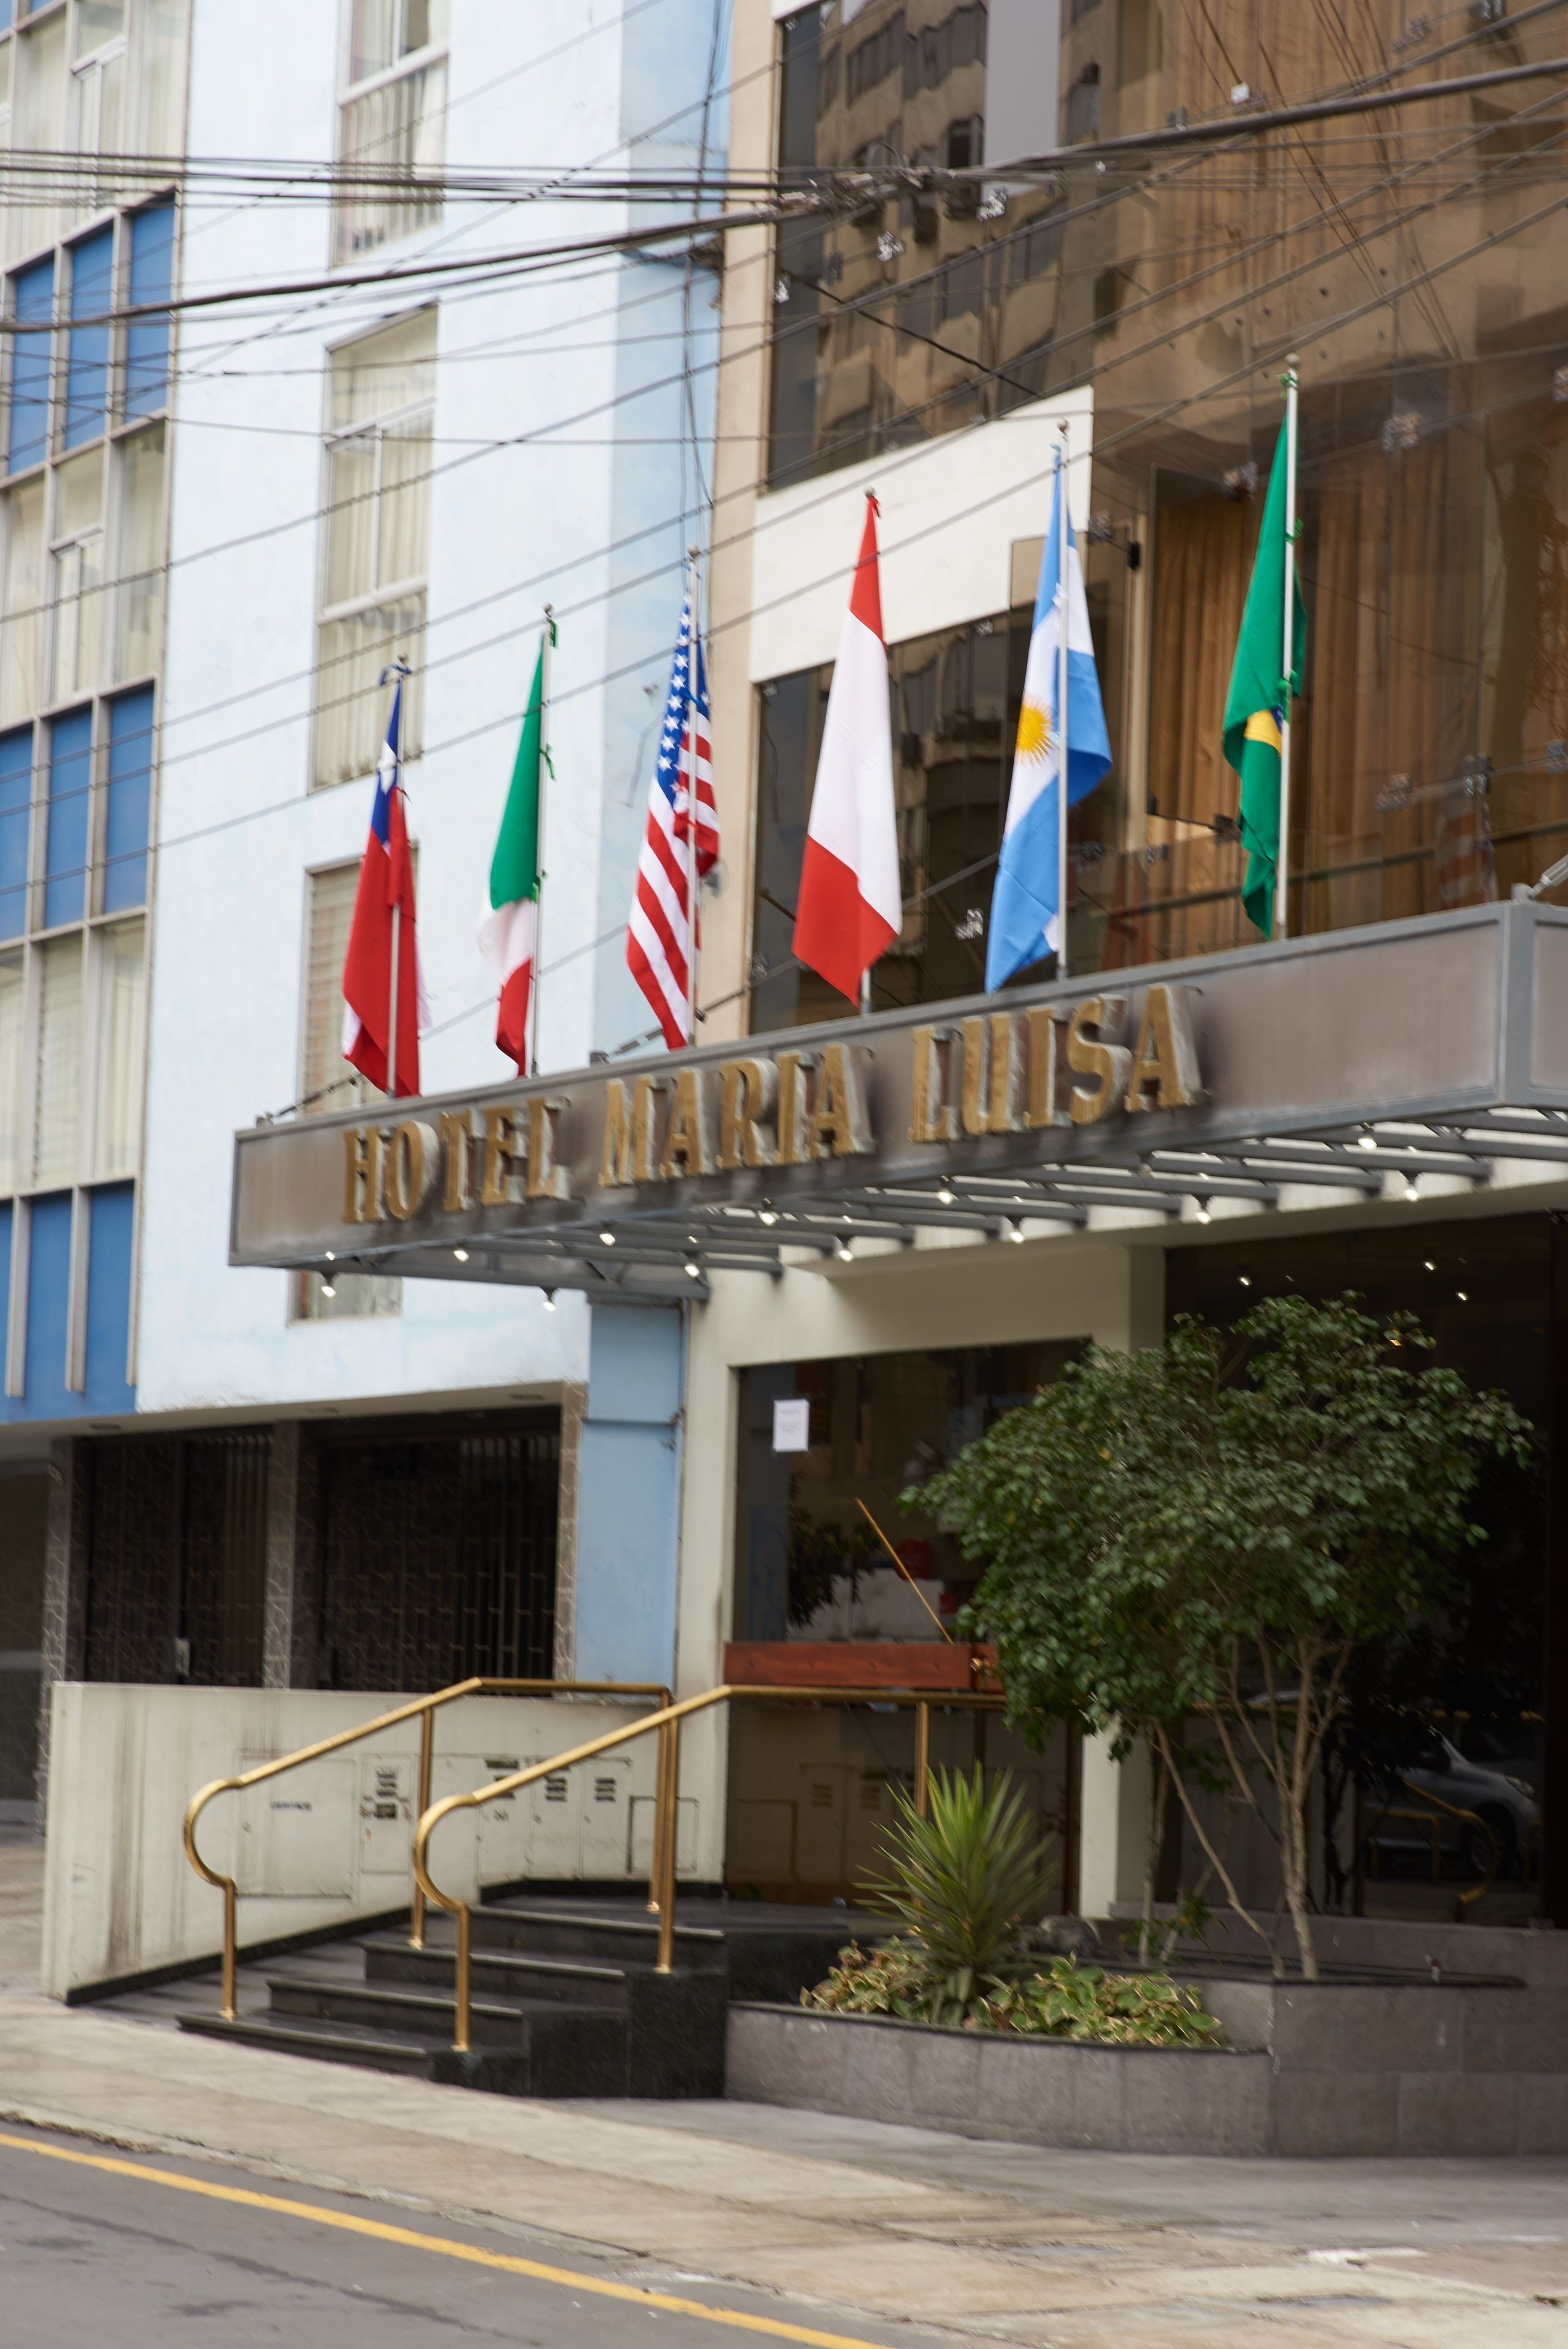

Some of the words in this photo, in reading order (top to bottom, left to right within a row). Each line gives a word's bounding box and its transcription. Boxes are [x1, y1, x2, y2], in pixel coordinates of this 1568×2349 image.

[342, 1097, 569, 1223] HOTEL
[598, 1042, 871, 1187] MARIA
[908, 983, 1199, 1143] LUISA
